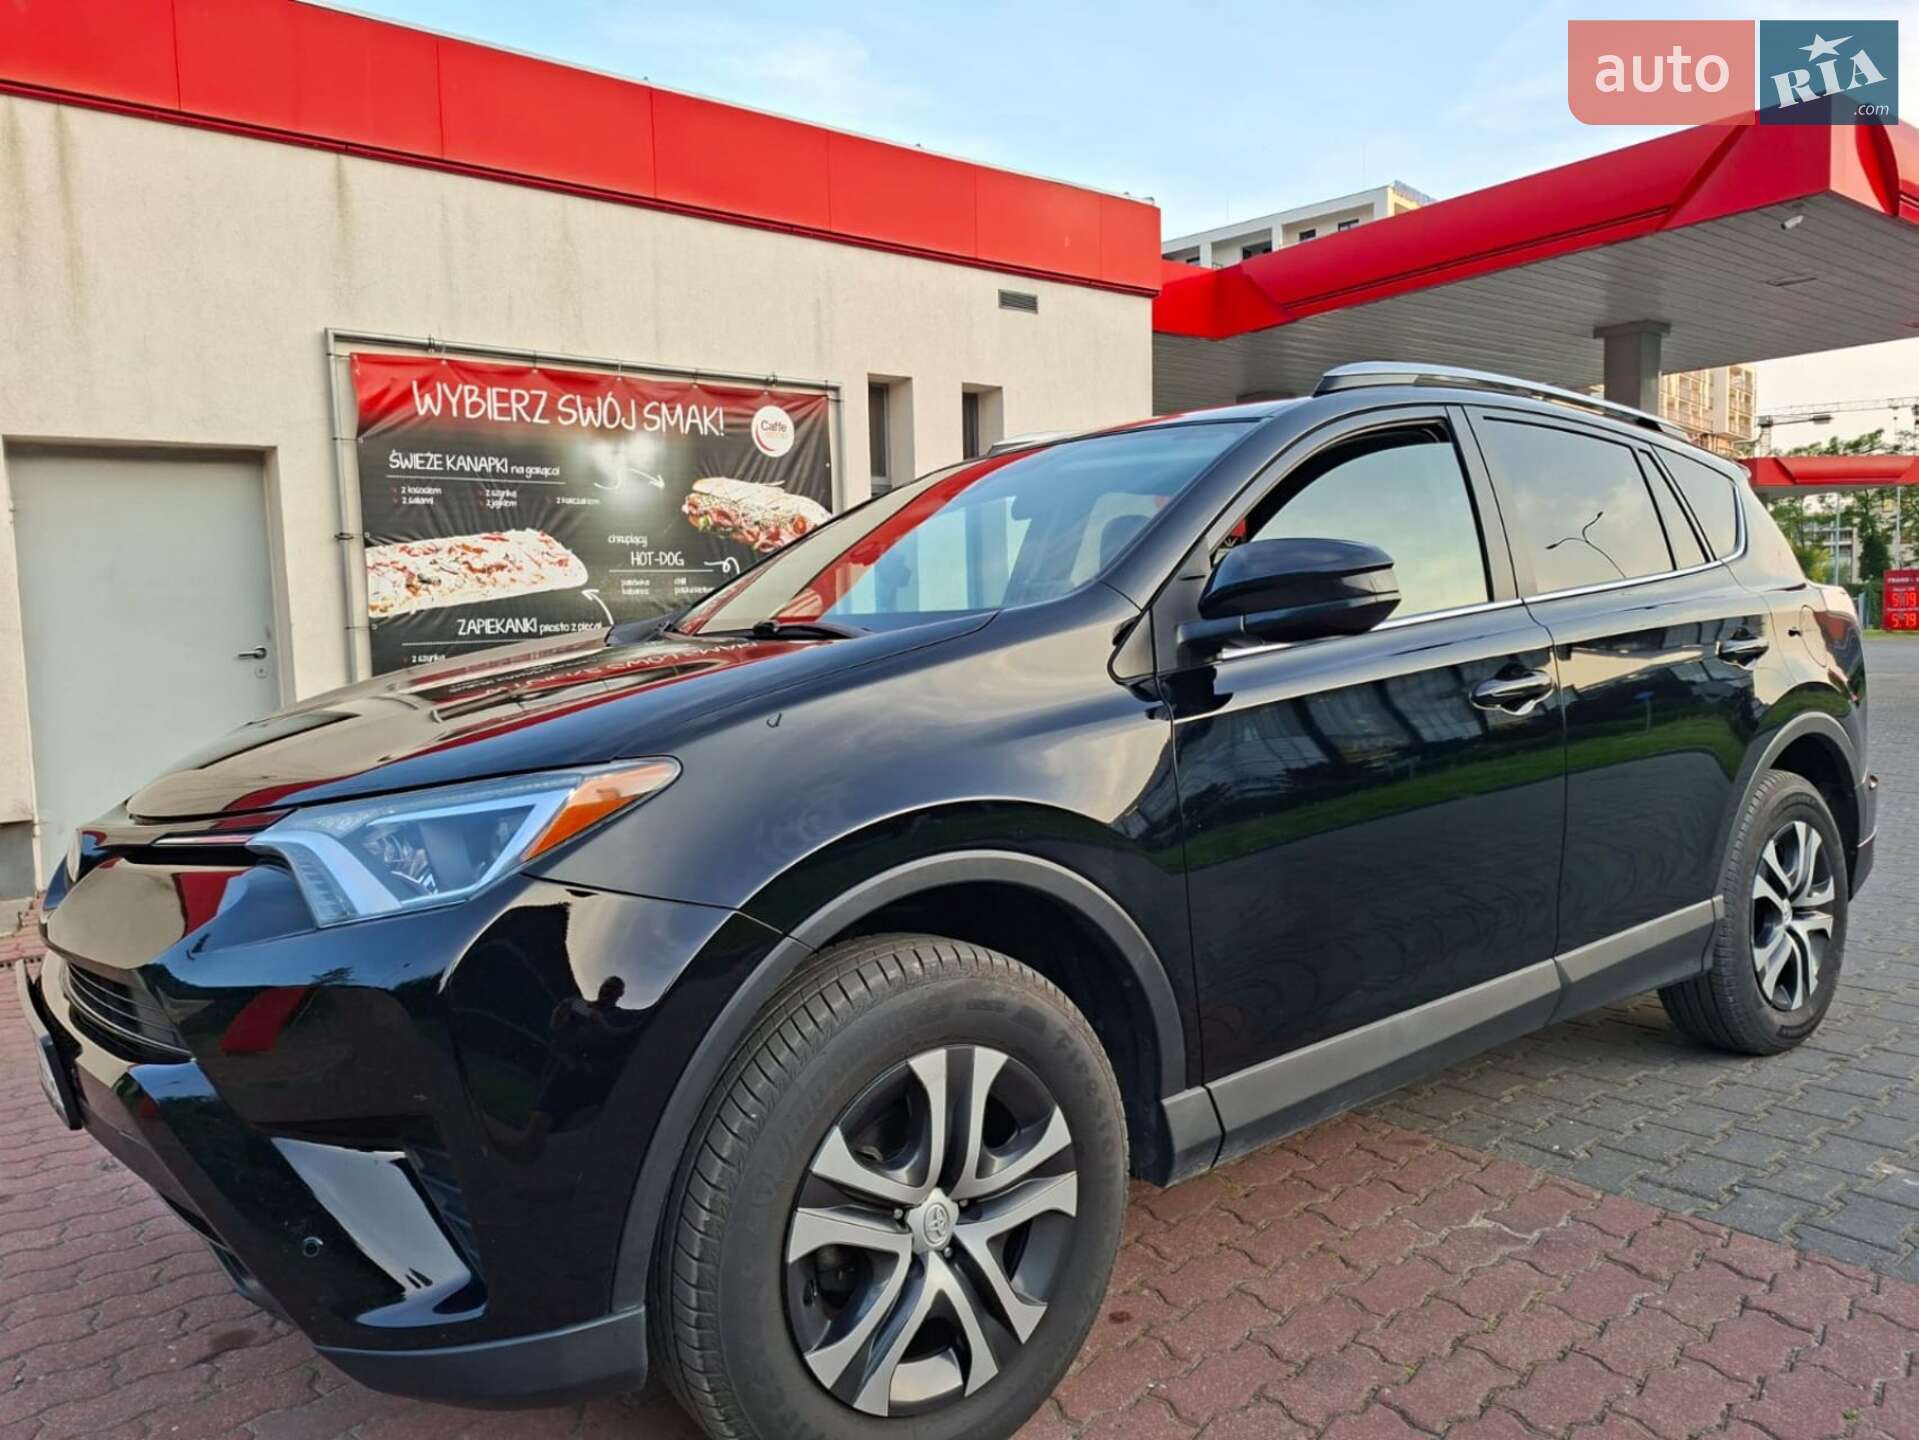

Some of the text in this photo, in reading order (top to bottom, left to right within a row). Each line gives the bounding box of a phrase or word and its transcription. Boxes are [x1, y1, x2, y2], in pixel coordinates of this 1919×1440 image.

[412, 380, 726, 437] WYBIERZ SWÓJ SMAK!
[760, 419, 788, 433] Caffe
[388, 449, 444, 471] ŚWIEŻE
[446, 453, 509, 474] KANAPKI
[510, 465, 524, 475] na
[630, 551, 685, 567] HOT-DOG
[456, 617, 538, 636] ZAPIEKANKI
